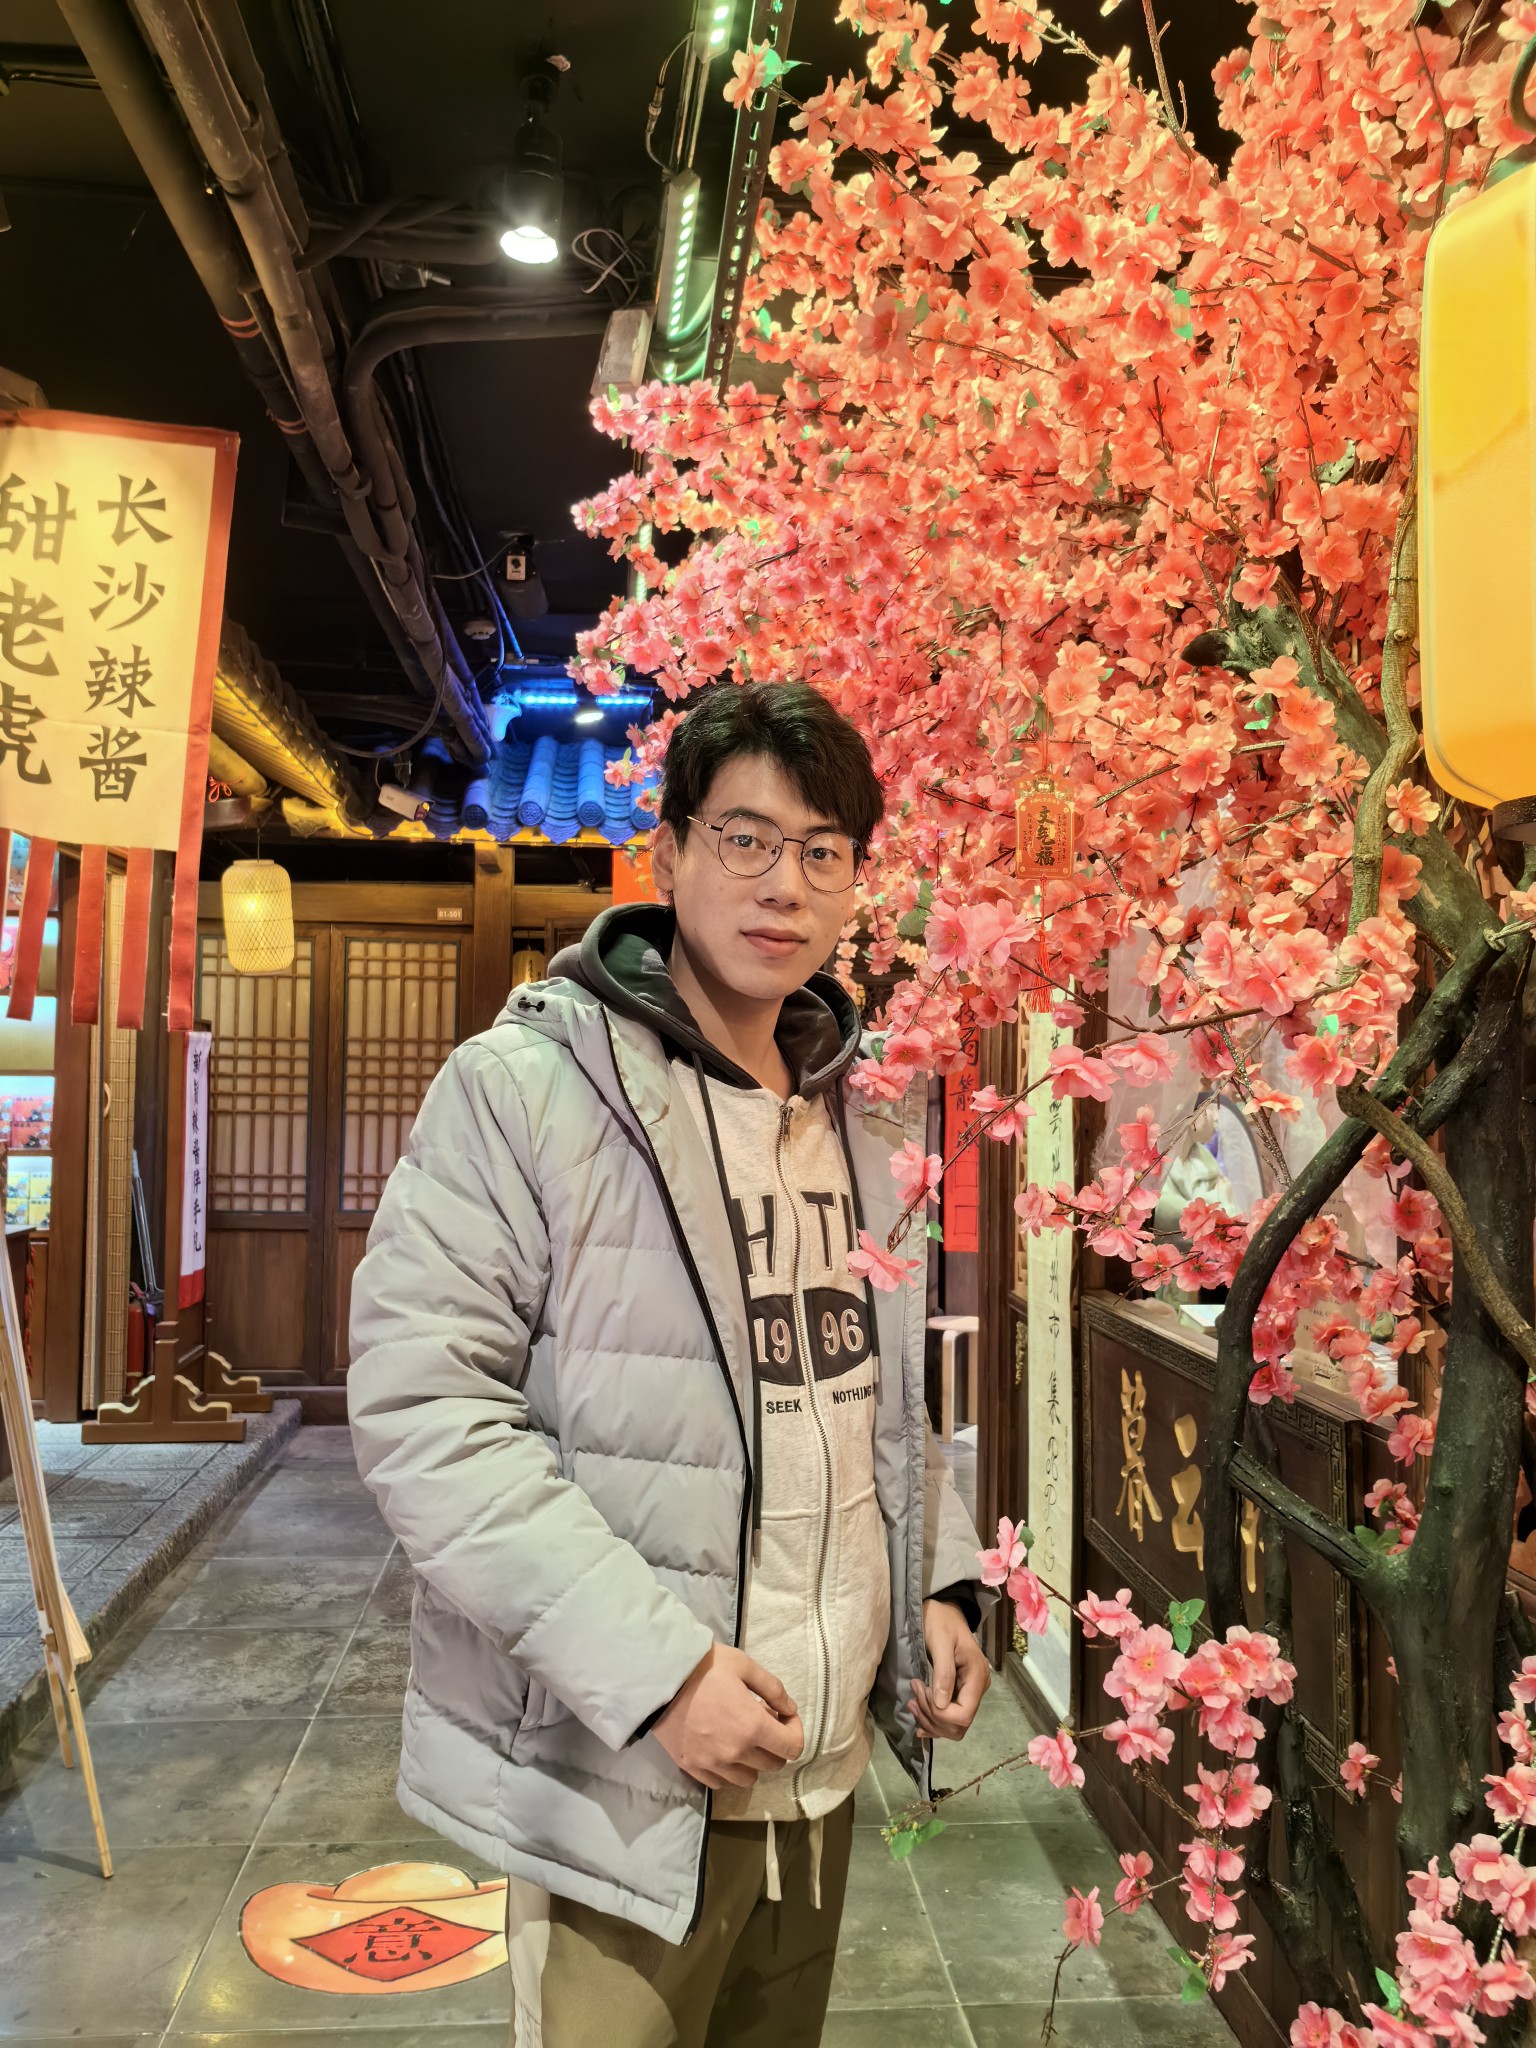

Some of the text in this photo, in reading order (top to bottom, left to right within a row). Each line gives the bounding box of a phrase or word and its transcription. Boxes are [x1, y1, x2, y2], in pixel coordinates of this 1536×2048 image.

[0, 472, 76, 785] 甜老虎
[79, 474, 173, 802] 长沙辣酱
[766, 1385, 872, 1414] SEEK NOTHING
[344, 1918, 443, 1963] 意
